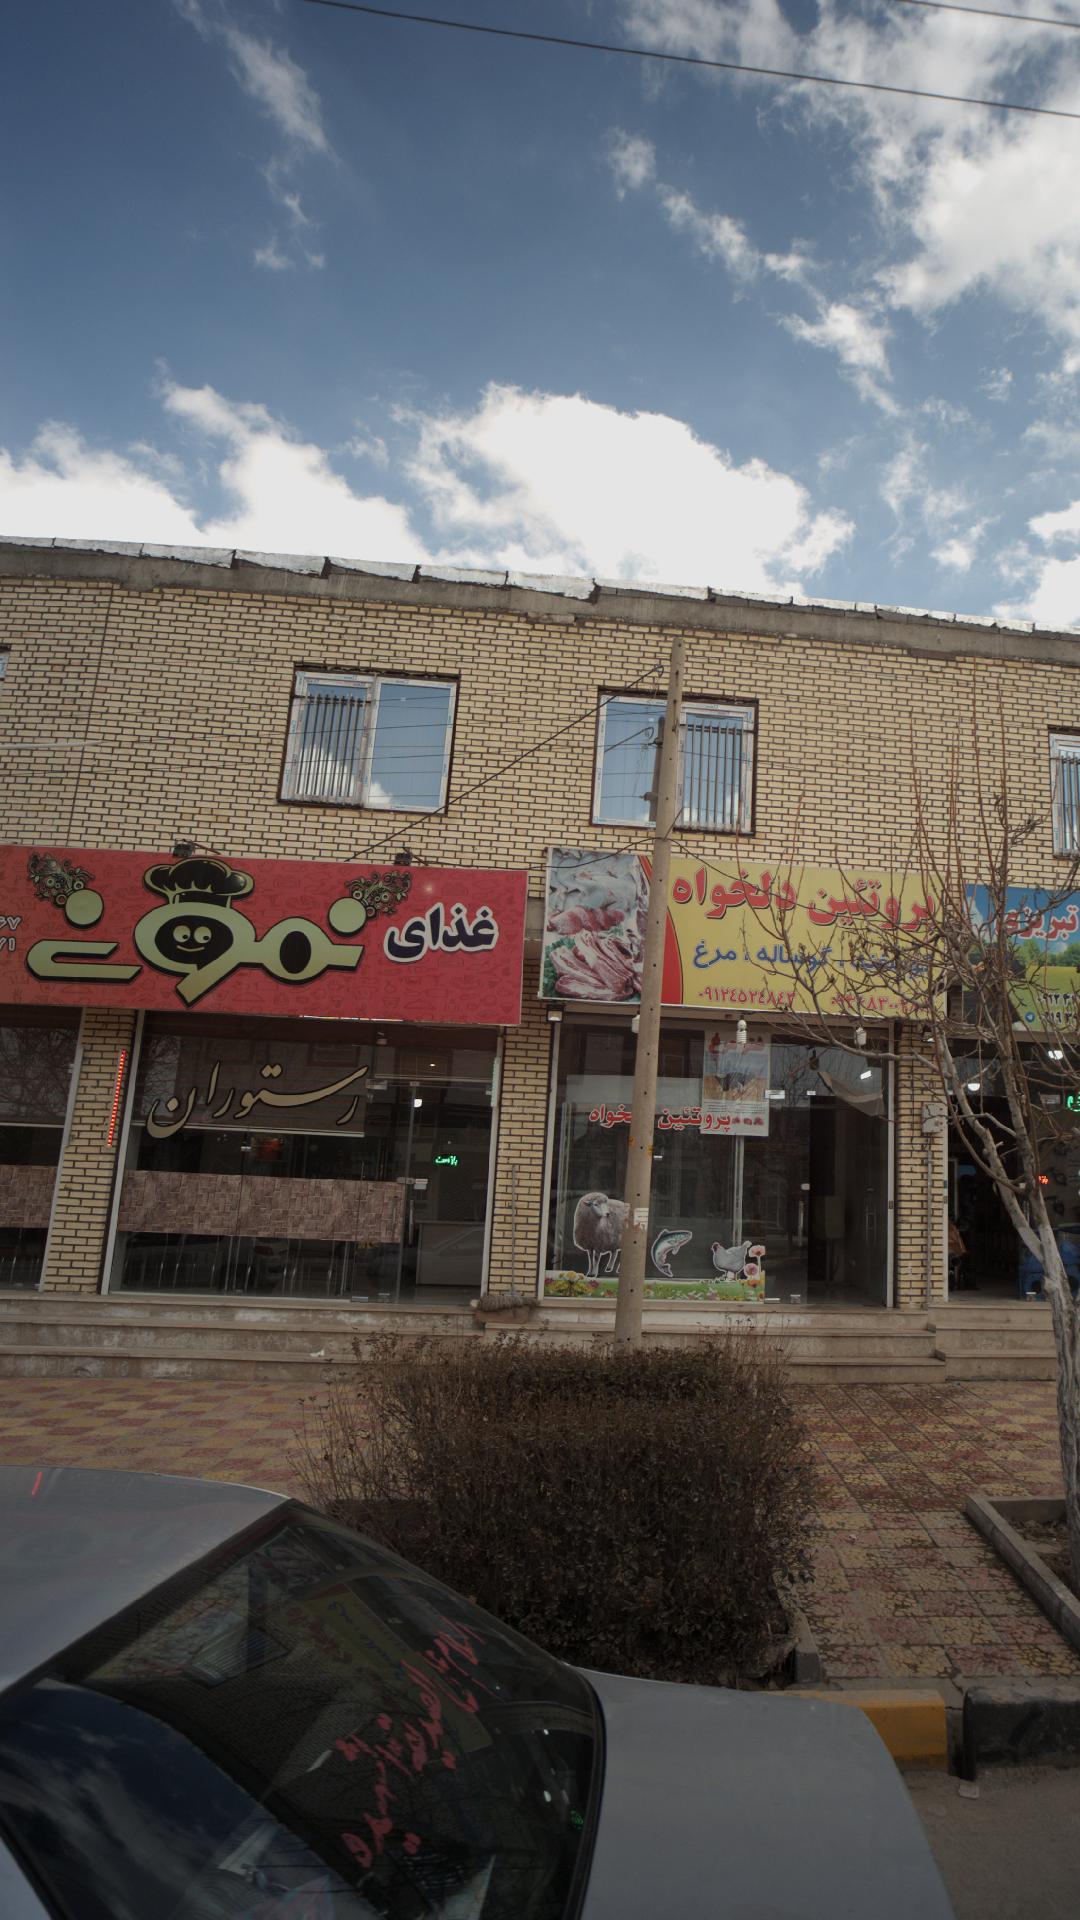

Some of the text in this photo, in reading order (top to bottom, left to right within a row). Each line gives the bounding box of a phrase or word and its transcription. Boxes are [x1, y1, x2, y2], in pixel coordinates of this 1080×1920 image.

[672, 865, 798, 919] دلخواه
[384, 902, 500, 963] غذای
[693, 938, 737, 969] مرغ
[145, 1061, 369, 1138] رستوران
[657, 1107, 732, 1132] پروتئین
